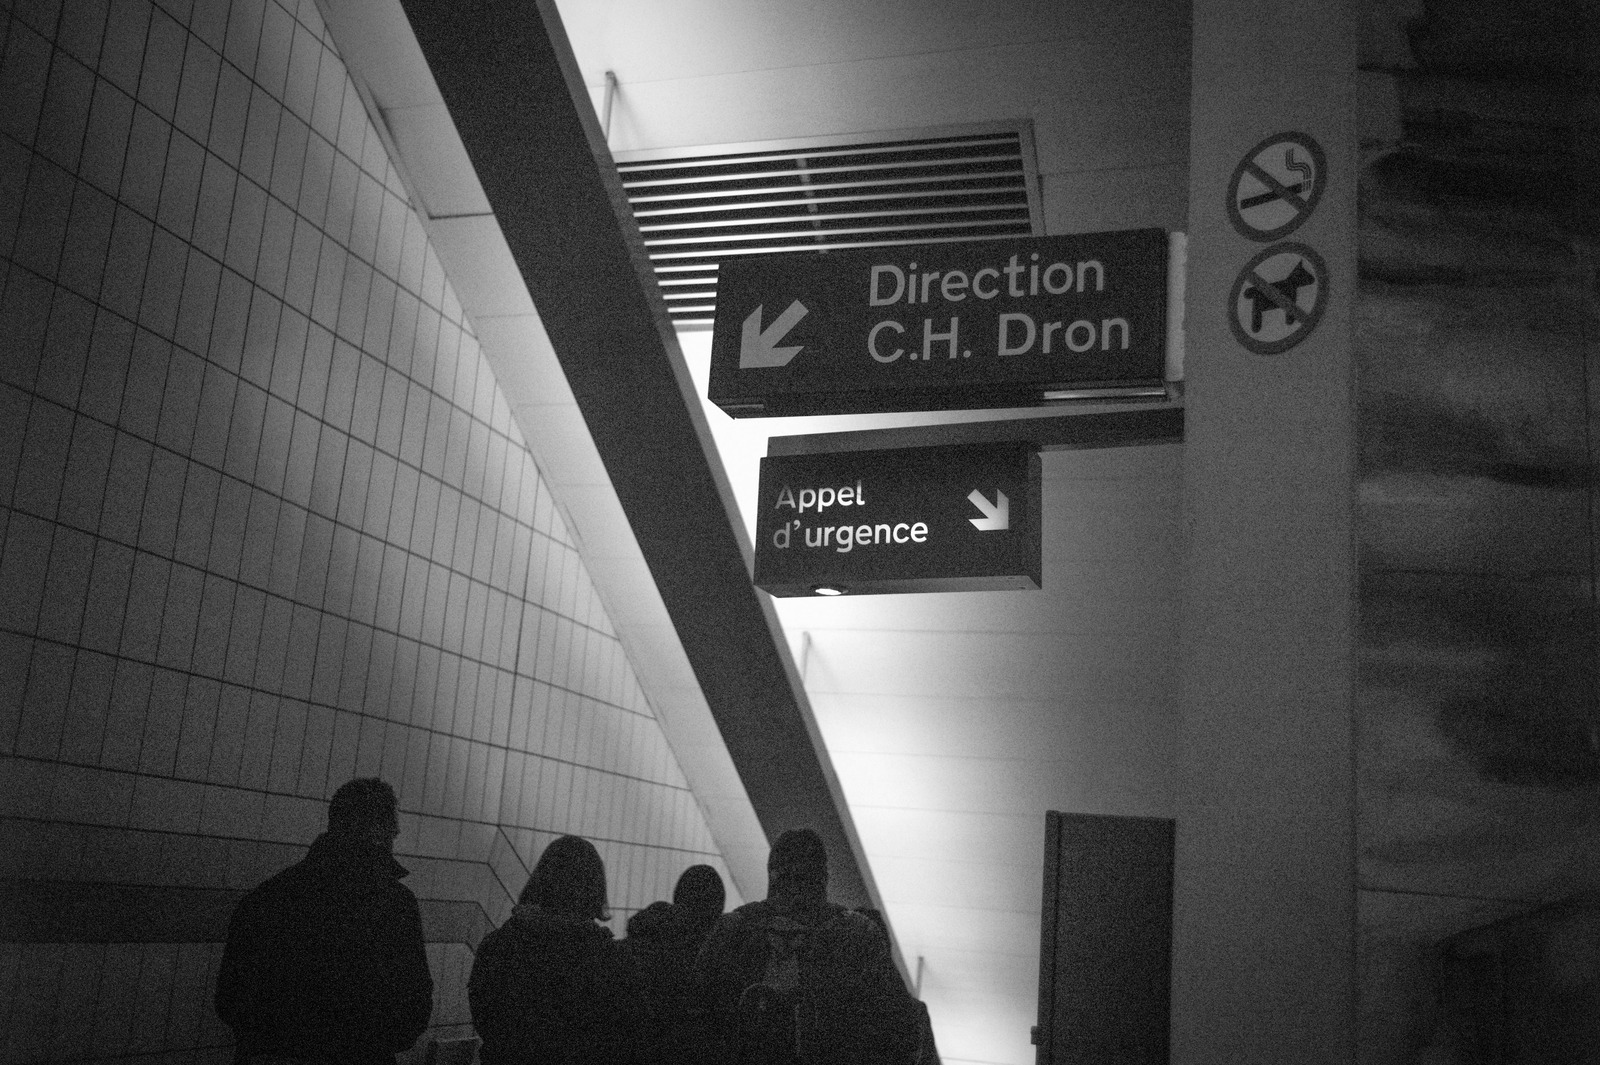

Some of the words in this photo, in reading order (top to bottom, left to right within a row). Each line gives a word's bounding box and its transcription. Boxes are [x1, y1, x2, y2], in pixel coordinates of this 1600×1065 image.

[869, 252, 1105, 306] Direction
[867, 316, 972, 363] C.H.
[998, 312, 1130, 357] Dron
[775, 479, 865, 513] Appel
